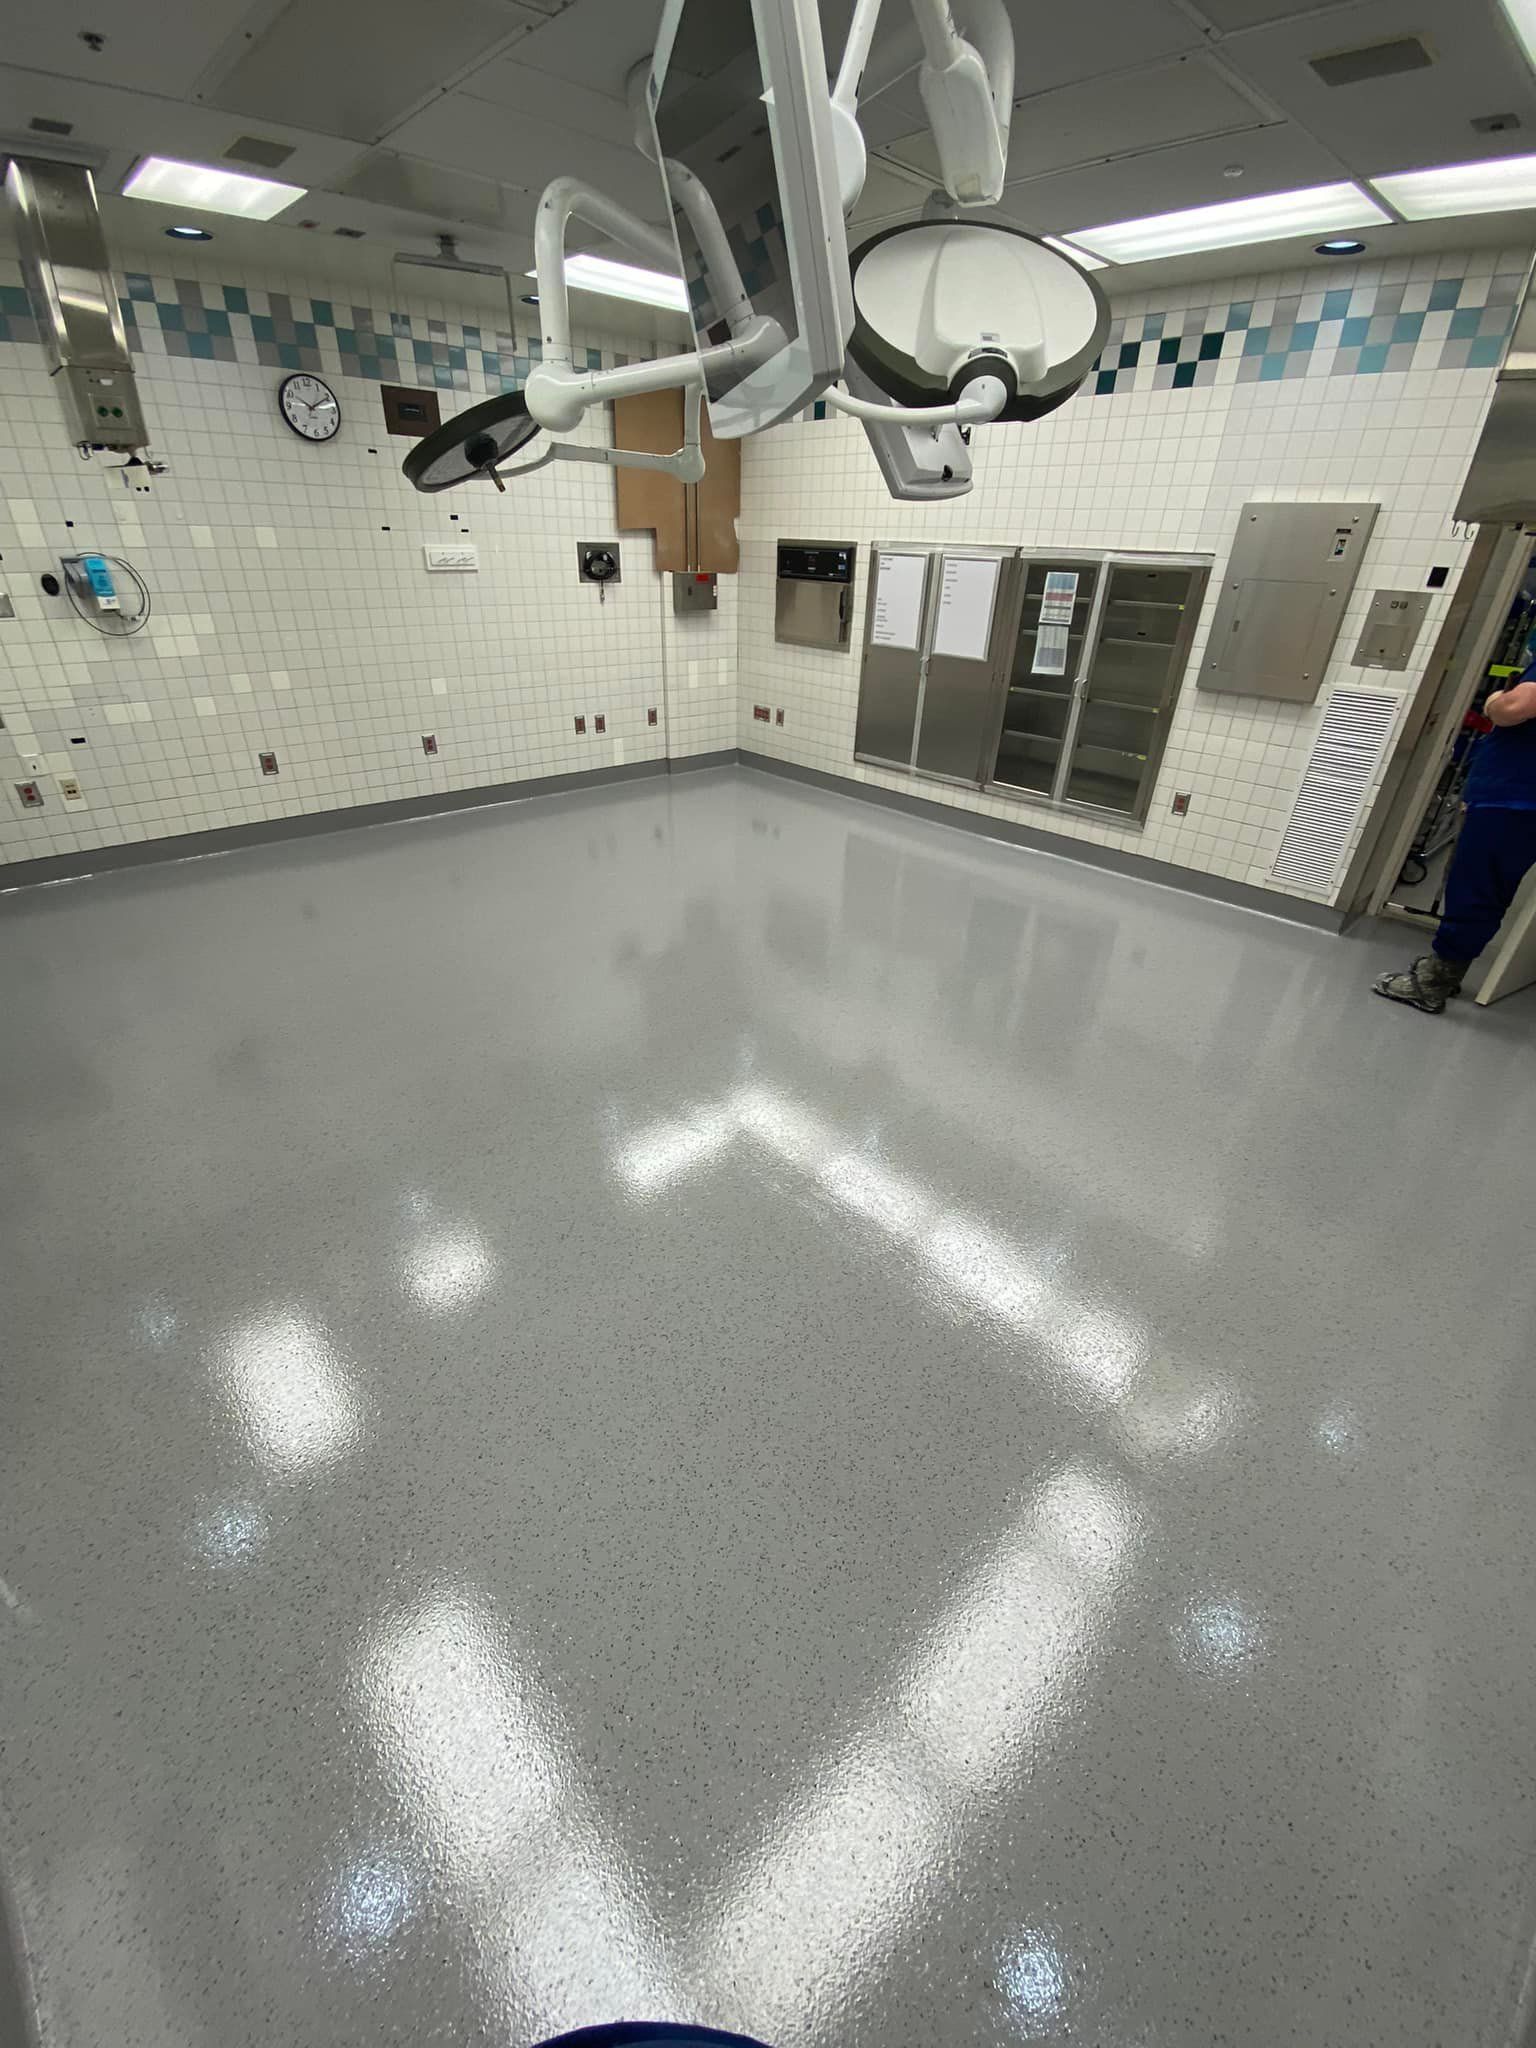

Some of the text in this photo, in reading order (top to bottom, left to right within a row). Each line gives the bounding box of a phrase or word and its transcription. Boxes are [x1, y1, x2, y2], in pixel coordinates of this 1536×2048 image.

[294, 381, 300, 390] 11
[303, 378, 312, 387] 12
[316, 383, 320, 392] 1
[325, 393, 330, 402] 2
[286, 402, 291, 410] 9
[331, 407, 336, 415] 3
[302, 424, 308, 433] 7
[324, 426, 329, 435] 5
